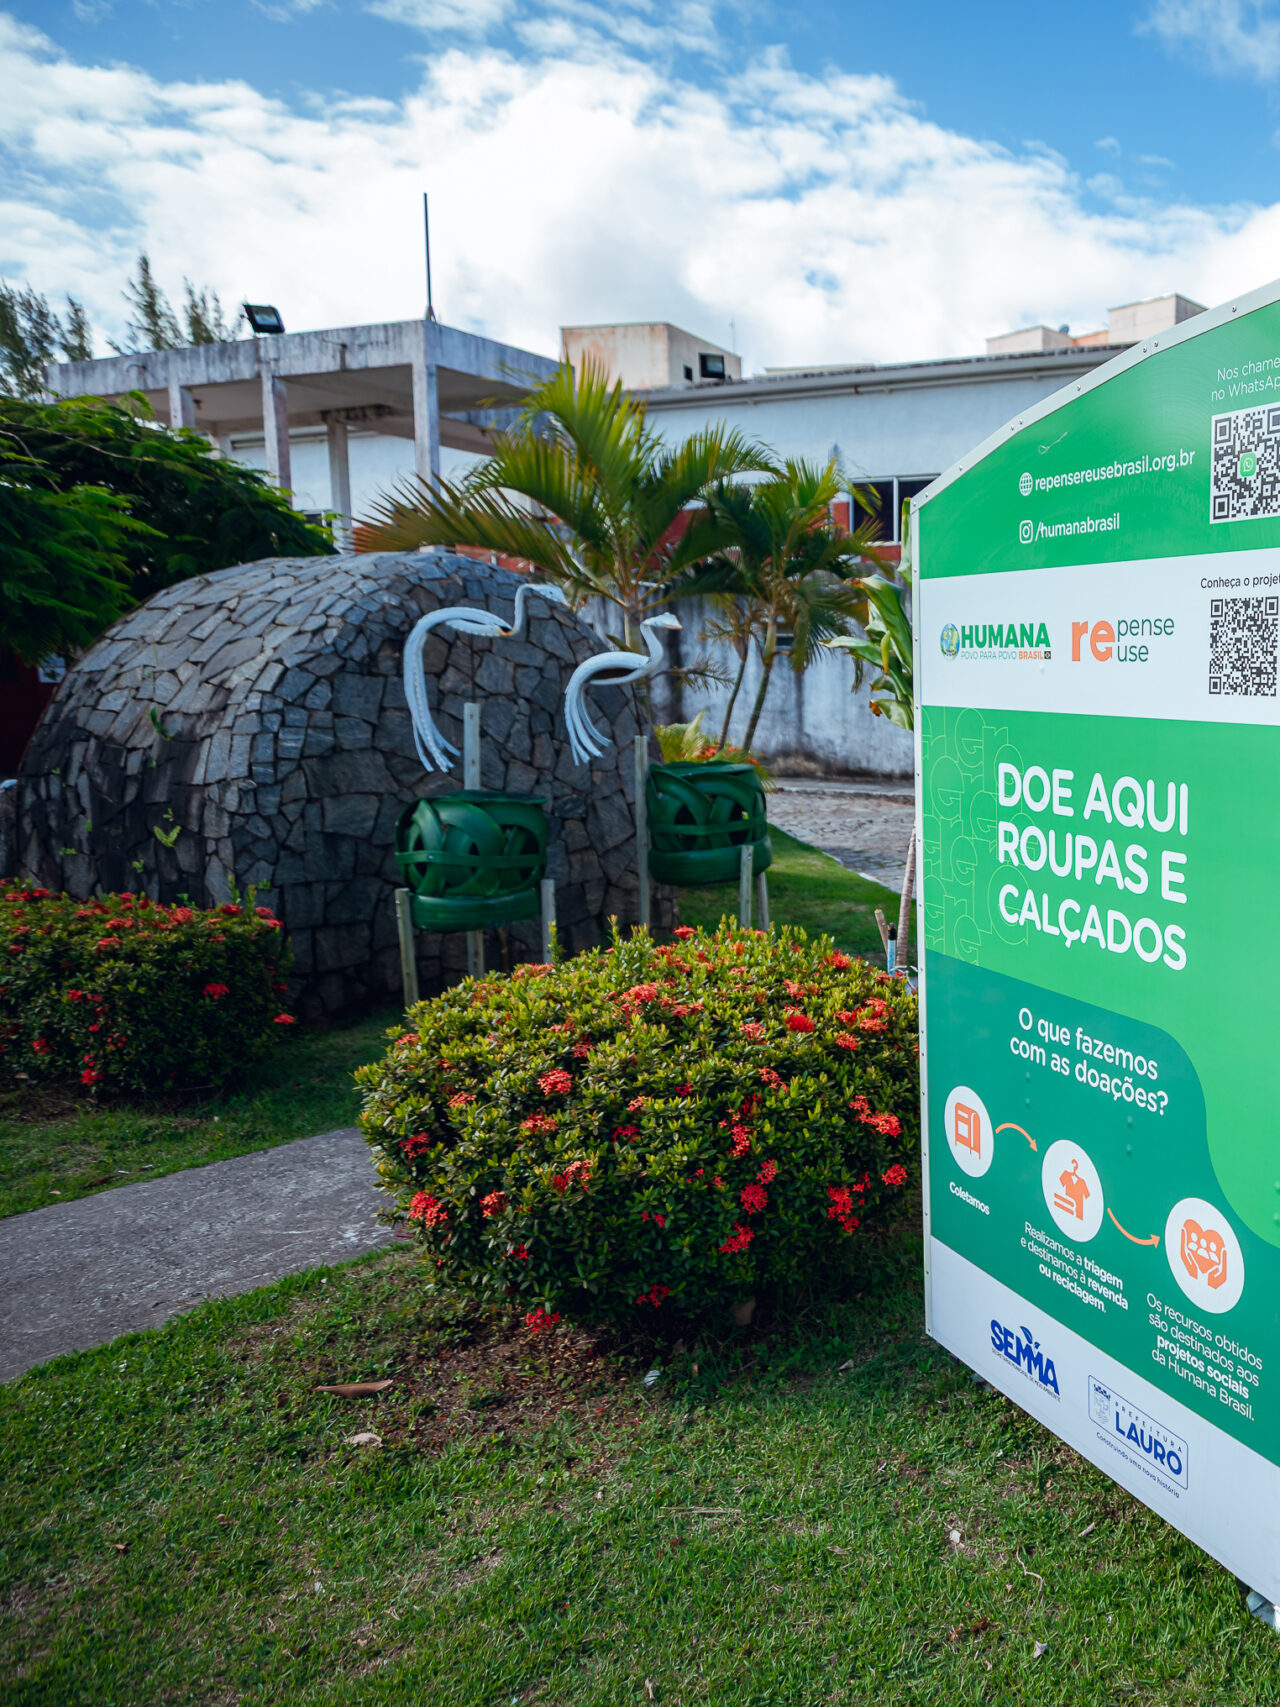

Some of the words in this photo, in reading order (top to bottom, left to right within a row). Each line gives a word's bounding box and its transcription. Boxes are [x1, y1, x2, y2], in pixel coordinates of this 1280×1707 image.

[1211, 388, 1226, 402] no
[1218, 368, 1239, 382] Nos
[1242, 356, 1280, 378] chame
[1034, 449, 1196, 492] repensereusebrasil.org.br
[1035, 513, 1120, 542] /humanabrasil
[1200, 574, 1240, 590] Conheça
[1244, 578, 1250, 587] o
[961, 622, 1051, 648] HUMANA
[961, 652, 978, 660] POVO
[980, 652, 996, 660] PARA
[998, 651, 1016, 660] POVO
[1018, 650, 1044, 660] BRASIL
[1117, 618, 1174, 642] pense
[1117, 644, 1148, 662] use
[998, 762, 1074, 817] DOE
[1083, 773, 1188, 836] AQUI
[998, 821, 1148, 894] ROUPAS
[1161, 850, 1188, 904] E
[998, 884, 1187, 970] CALÇADOS
[1010, 1036, 1046, 1066] com
[1050, 1056, 1070, 1076] as
[1074, 1060, 1169, 1116] doações?
[1018, 1007, 1033, 1030] O
[1037, 1017, 1071, 1046] que
[1075, 1028, 1158, 1080] fazemos
[949, 1180, 990, 1216] Coletamos
[1020, 1238, 1027, 1248] e
[1028, 1238, 1078, 1280] destinamos
[1080, 1268, 1086, 1283] à
[1087, 1276, 1128, 1310] revenda
[1024, 1221, 1074, 1262] Realizamos
[1075, 1254, 1082, 1265] a
[1084, 1256, 1124, 1291] triagem
[1039, 1264, 1050, 1279] ou
[1052, 1268, 1106, 1314] reciclagem.
[990, 1320, 1060, 1396] SEMMA
[1146, 1292, 1162, 1312] Os
[1164, 1302, 1212, 1340] recursos
[1214, 1328, 1263, 1370] obtidos
[1148, 1312, 1168, 1334] são
[1170, 1318, 1234, 1373] destinados
[1236, 1363, 1260, 1387] aos
[1152, 1348, 1166, 1366] da
[1168, 1356, 1217, 1400] Humana
[1220, 1382, 1255, 1422] Brasil.
[1156, 1335, 1204, 1376] projetos
[1206, 1358, 1250, 1400] sociais
[1115, 1401, 1182, 1454] PREFEITURA
[1116, 1410, 1182, 1476] LAURO
[1096, 1432, 1128, 1460] Construindo
[1129, 1456, 1142, 1470] uma
[1142, 1466, 1156, 1482] nova
[1156, 1476, 1180, 1498] história
